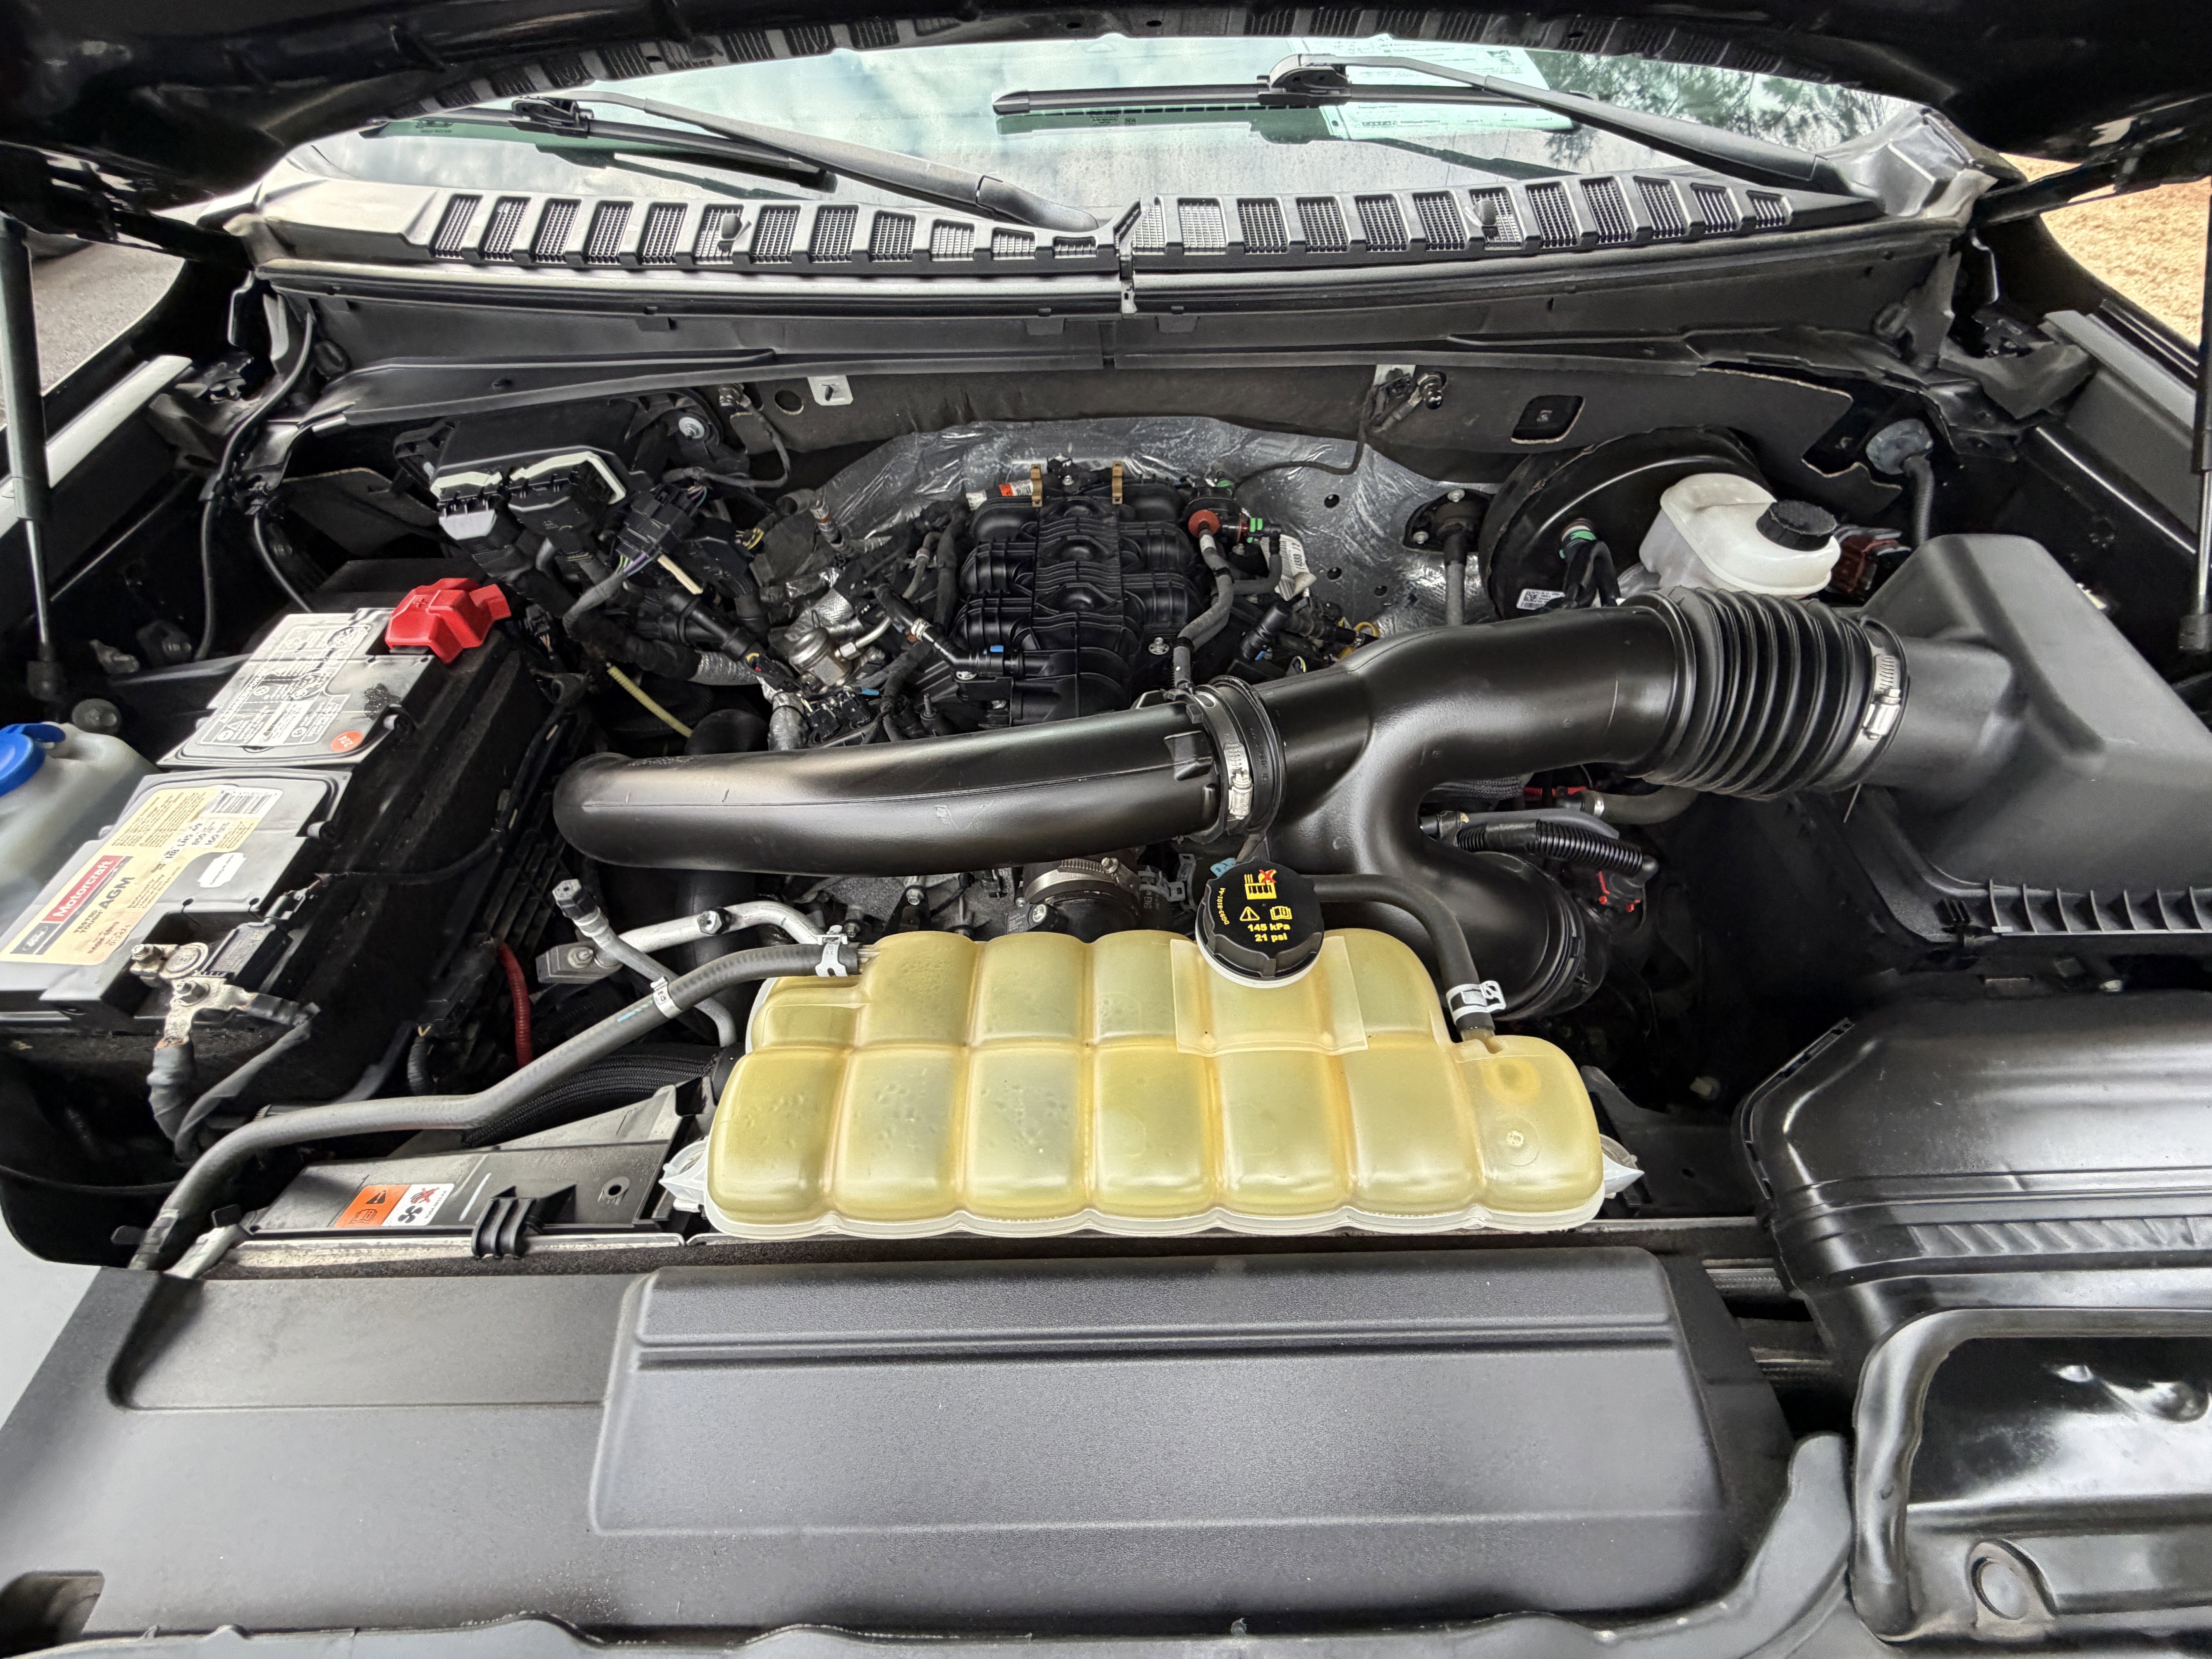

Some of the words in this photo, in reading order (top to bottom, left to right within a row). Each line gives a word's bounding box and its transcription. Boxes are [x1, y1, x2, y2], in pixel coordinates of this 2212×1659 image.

[53, 860, 114, 917] Motorcraft
[98, 877, 135, 909] AGM
[1247, 923, 1267, 932] 145
[1269, 923, 1291, 931] kPa
[1255, 934, 1268, 942] 21
[1271, 933, 1288, 943] psi
